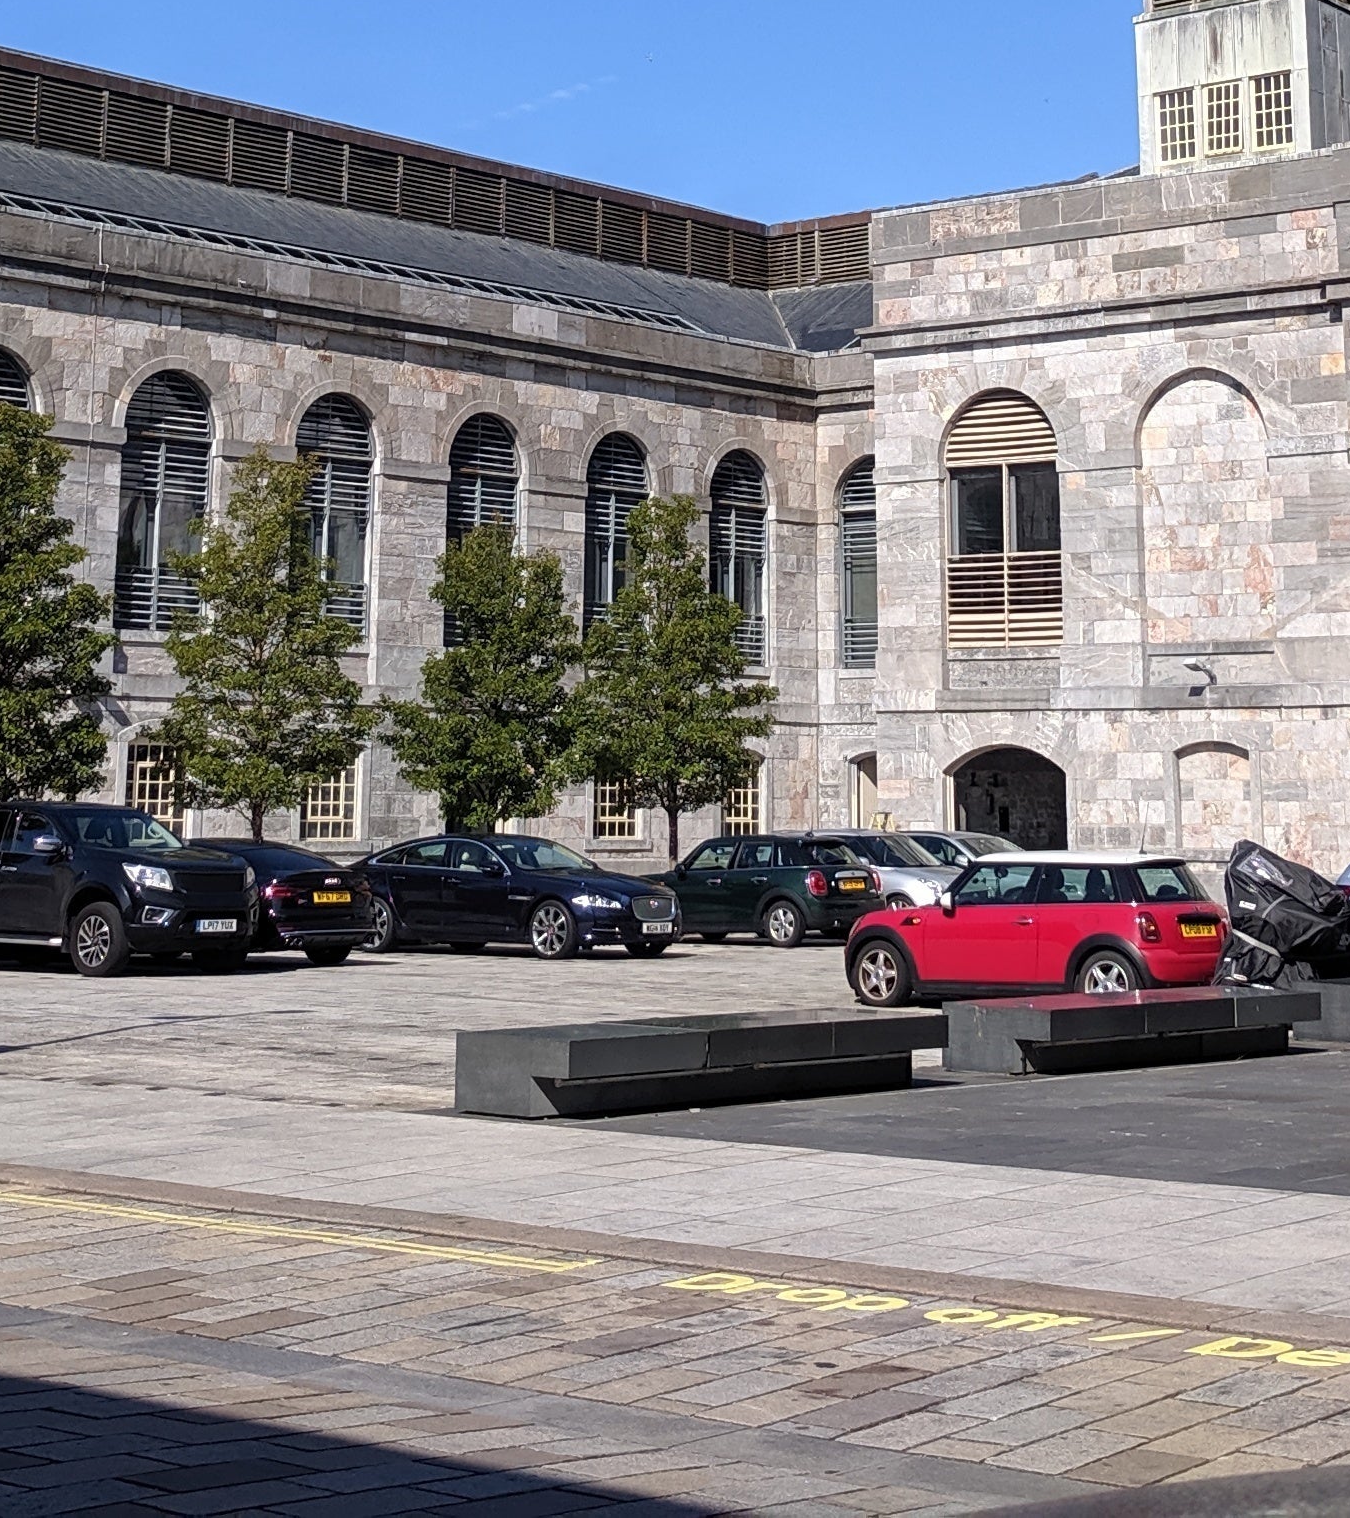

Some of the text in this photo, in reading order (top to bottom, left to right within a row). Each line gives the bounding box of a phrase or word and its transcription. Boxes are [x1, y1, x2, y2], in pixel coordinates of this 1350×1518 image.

[202, 920, 234, 930] LP17 YUX
[662, 1272, 910, 1312] Drop
[923, 1307, 1095, 1333] off
[1087, 1328, 1186, 1342] /
